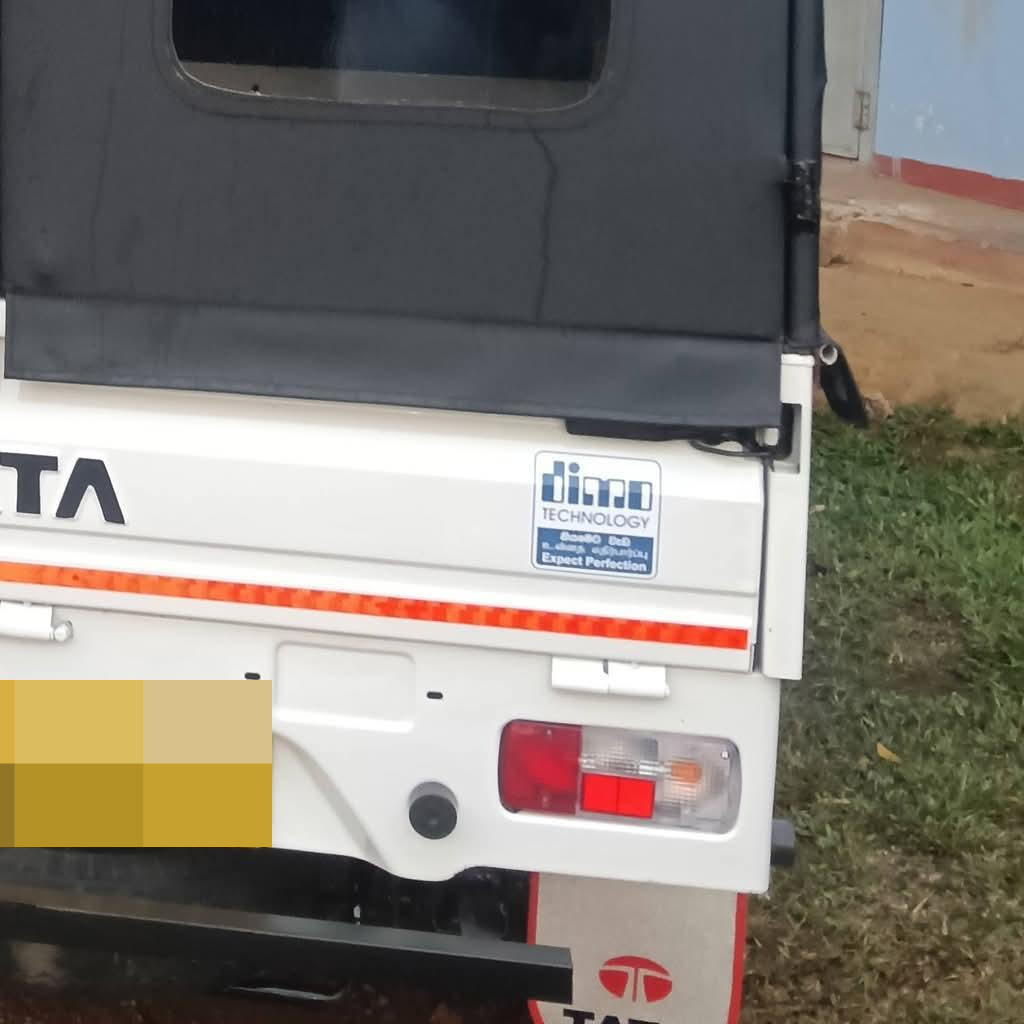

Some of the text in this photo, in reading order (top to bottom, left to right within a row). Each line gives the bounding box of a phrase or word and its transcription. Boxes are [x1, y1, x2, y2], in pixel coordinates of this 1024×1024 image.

[542, 507, 651, 529] TECHNOLOGY
[541, 551, 584, 567] Expect
[585, 556, 648, 572] Perfection
